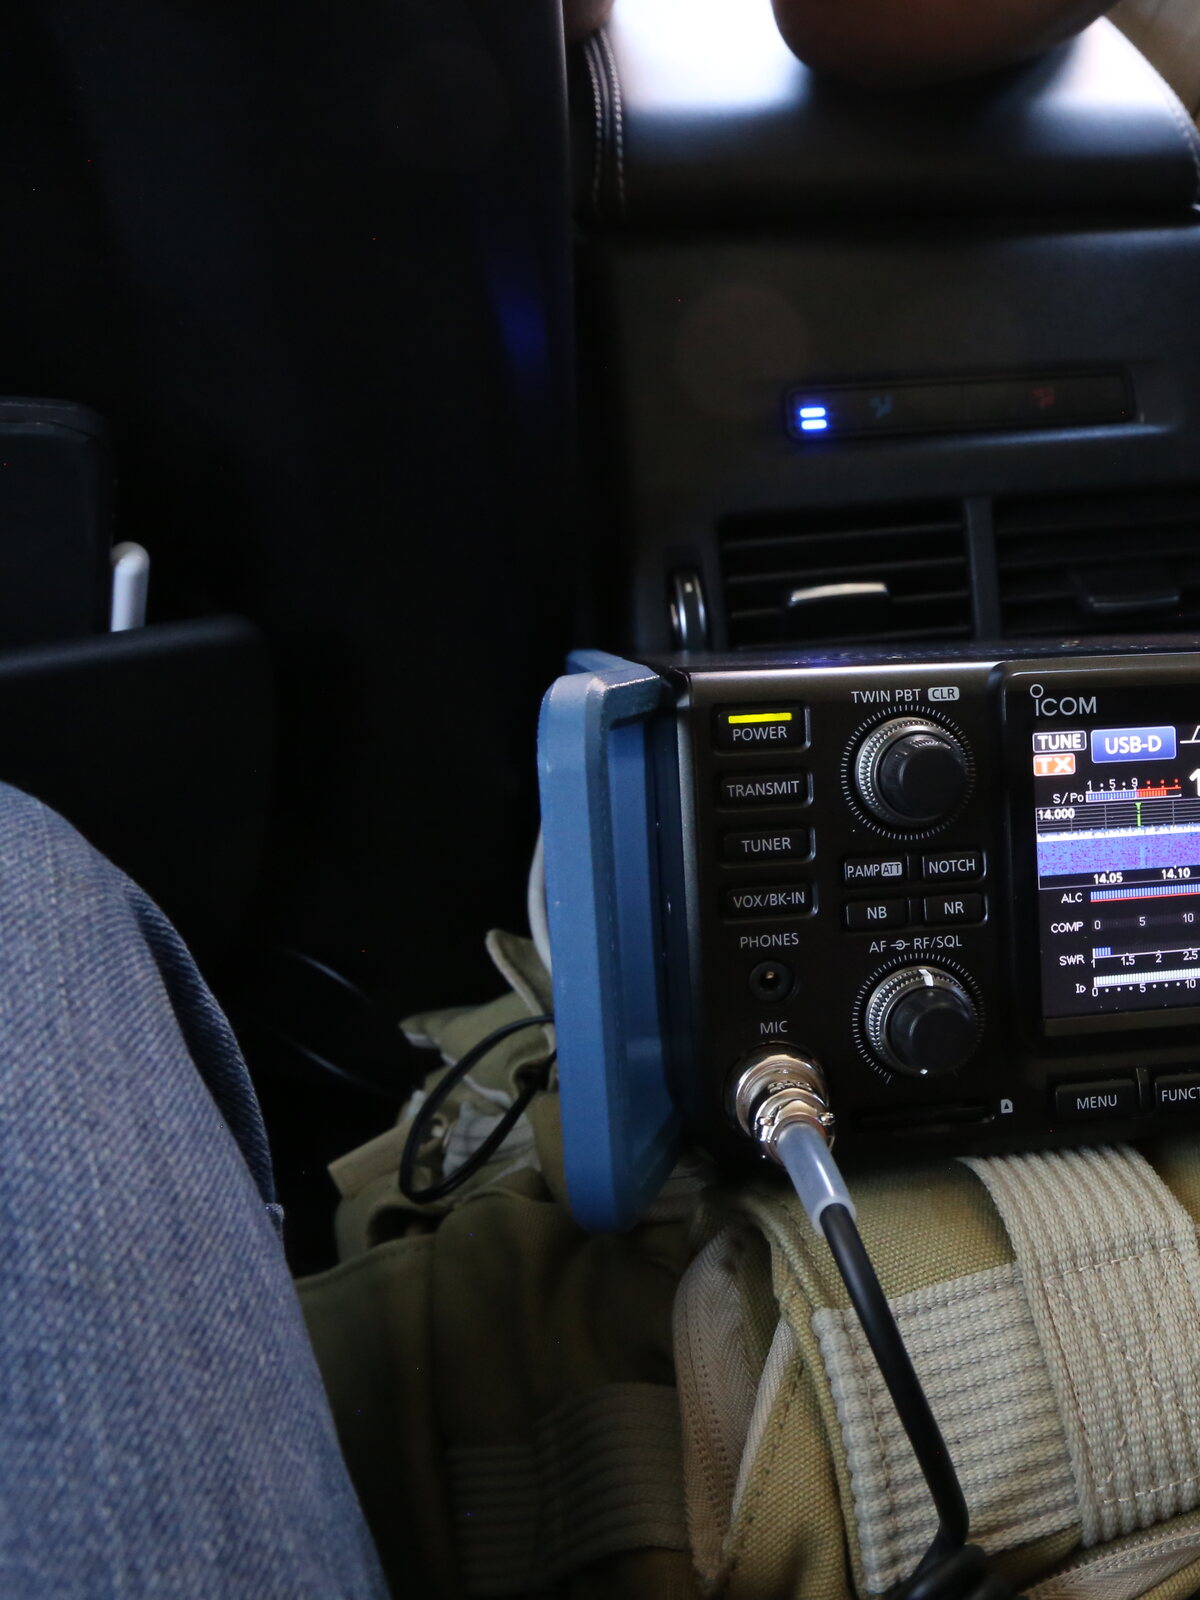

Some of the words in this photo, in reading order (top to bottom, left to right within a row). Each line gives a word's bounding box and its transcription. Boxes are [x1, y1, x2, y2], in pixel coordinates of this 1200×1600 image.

[851, 690, 890, 703] TWIN
[895, 688, 921, 702] PBT
[931, 688, 956, 700] CLR
[732, 726, 788, 741] POWER
[1037, 733, 1082, 750] TUNE
[1105, 735, 1162, 755] USB-D
[1036, 757, 1073, 773] TX
[726, 781, 800, 797] TRANSMIT
[1109, 779, 1116, 788] 5
[1131, 777, 1138, 788] 9
[1037, 808, 1075, 820] 14.000
[741, 837, 791, 852] TUNER
[847, 865, 880, 880] P.AMP
[882, 862, 902, 876] ATT
[929, 859, 975, 873] NOTCH
[1094, 872, 1123, 884] 14.05
[1161, 867, 1191, 879] 14.10
[733, 892, 805, 908] VOX/BK-IN
[1061, 893, 1083, 904] ALC
[867, 907, 887, 919] NB
[944, 902, 964, 914] NR
[1051, 922, 1084, 933] COMP
[1094, 920, 1101, 930] 0
[1139, 916, 1146, 926] 5
[1183, 913, 1194, 923] 10
[740, 933, 799, 948] PHONES
[869, 941, 887, 953] AF
[913, 935, 962, 950] RF/SQL
[1059, 955, 1085, 966] SWR
[1121, 955, 1135, 966] 1.5
[1155, 953, 1162, 963] 2
[1183, 949, 1198, 960] 2.5
[1091, 987, 1098, 997] 0
[1139, 982, 1146, 993] 5
[1184, 978, 1196, 989] 10
[760, 1020, 788, 1034] MIC
[1076, 1094, 1118, 1110] MENU
